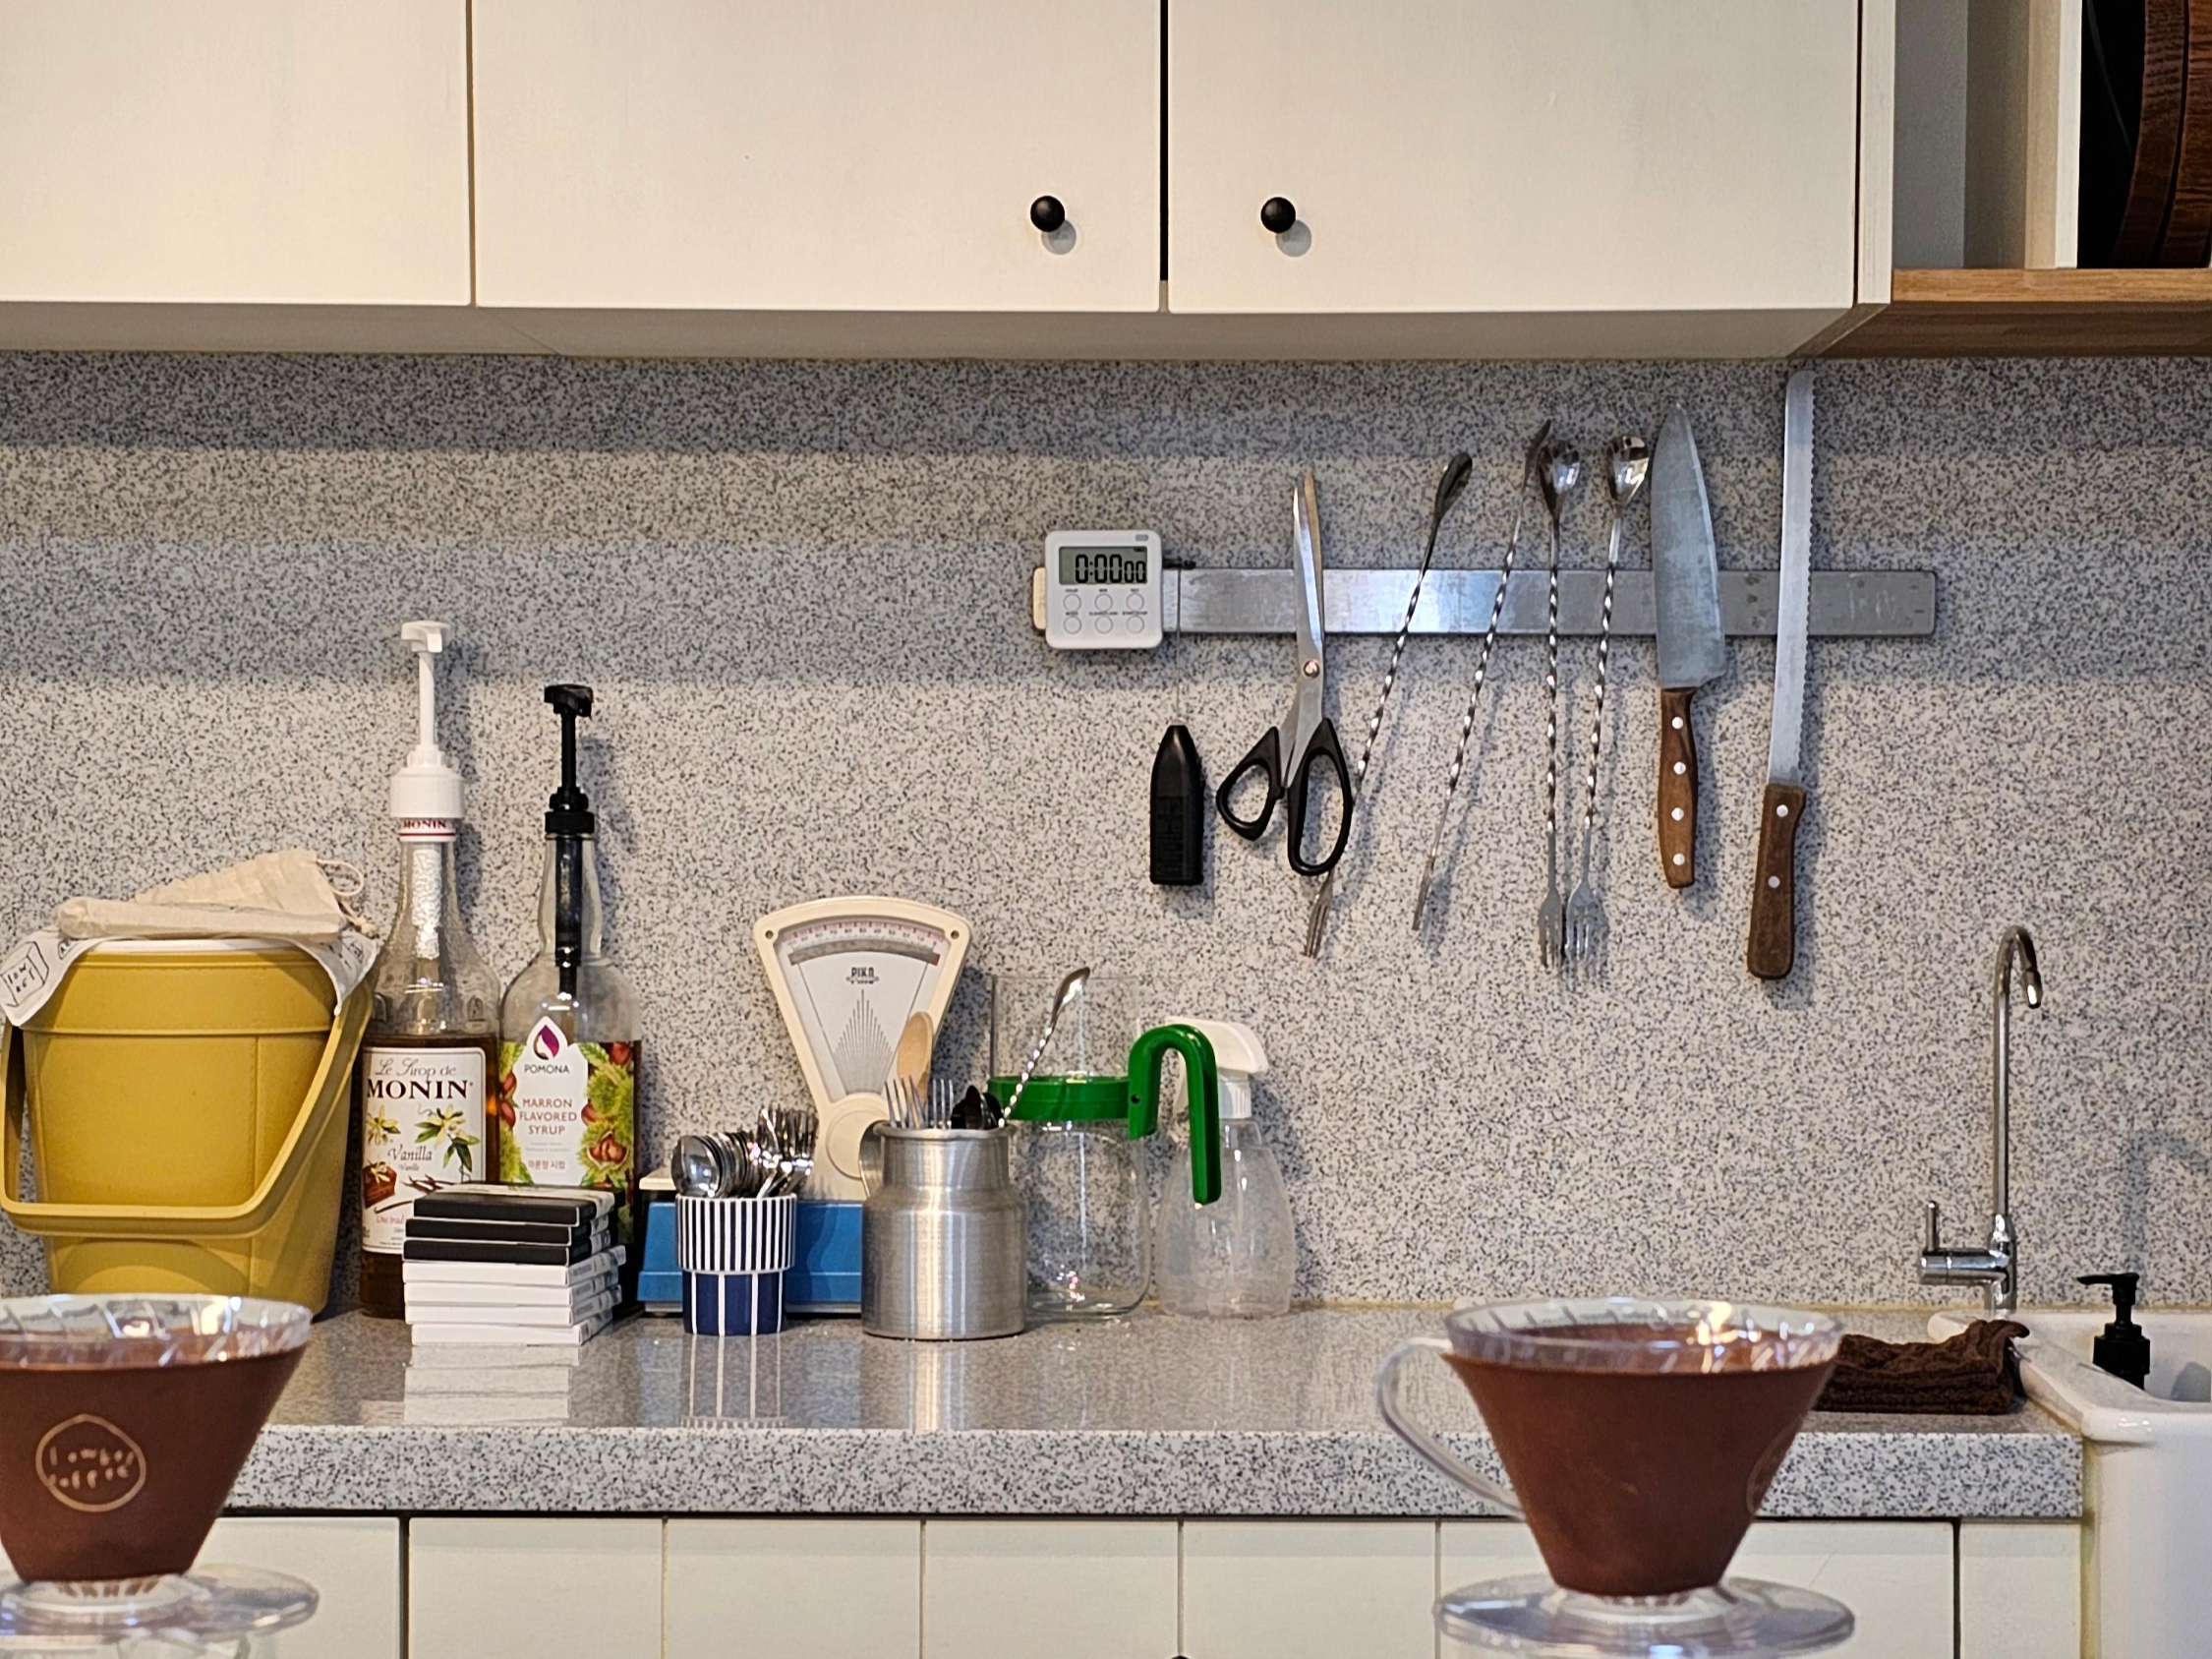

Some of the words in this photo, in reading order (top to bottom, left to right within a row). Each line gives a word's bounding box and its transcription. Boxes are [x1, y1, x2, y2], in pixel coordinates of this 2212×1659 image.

[403, 818, 446, 829] MONIN
[375, 1057, 394, 1076] Le
[396, 1057, 437, 1080] Sirop
[439, 1065, 457, 1076] de
[524, 1064, 570, 1074] POMONA
[367, 1079, 468, 1099] MONIN
[523, 1098, 572, 1108] MARRON
[519, 1112, 577, 1122] FLAVORED
[529, 1125, 565, 1135] SYRUP
[388, 1145, 433, 1161] Vanilla
